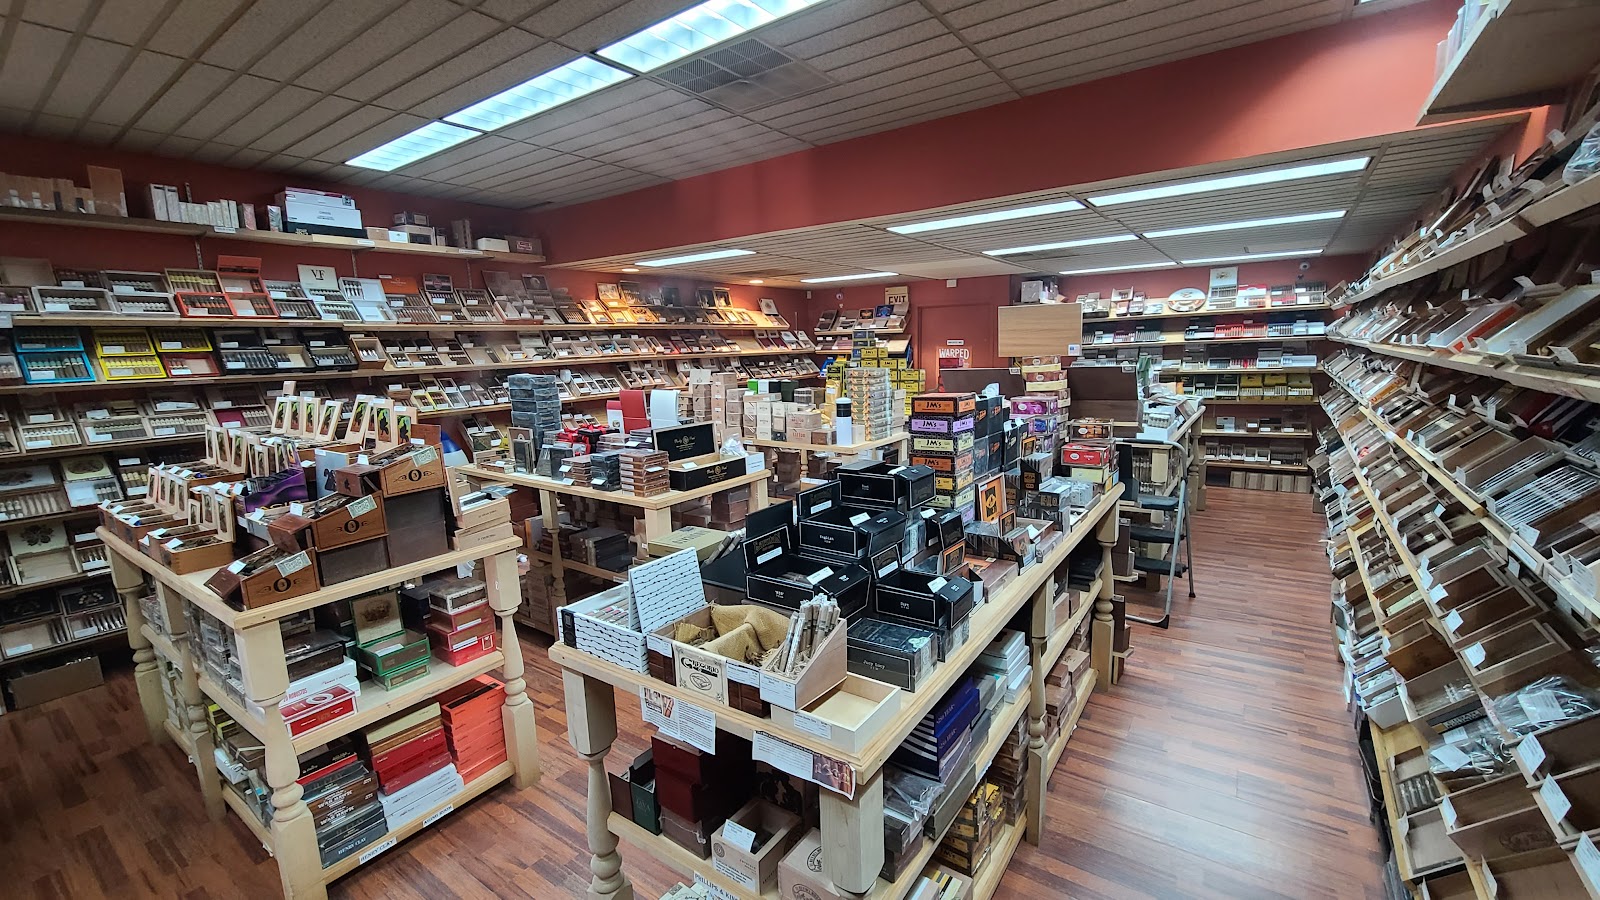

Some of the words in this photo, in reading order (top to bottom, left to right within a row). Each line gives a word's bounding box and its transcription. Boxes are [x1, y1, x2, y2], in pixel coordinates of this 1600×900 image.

[310, 269, 325, 279] VF
[938, 348, 969, 360] WARPED
[926, 401, 942, 409] JM's
[338, 843, 355, 855] HENRY
[355, 837, 367, 846] CLAY
[360, 847, 380, 862] HENRY
[379, 839, 394, 851] CLAY
[695, 873, 718, 892] PHILLIPS
